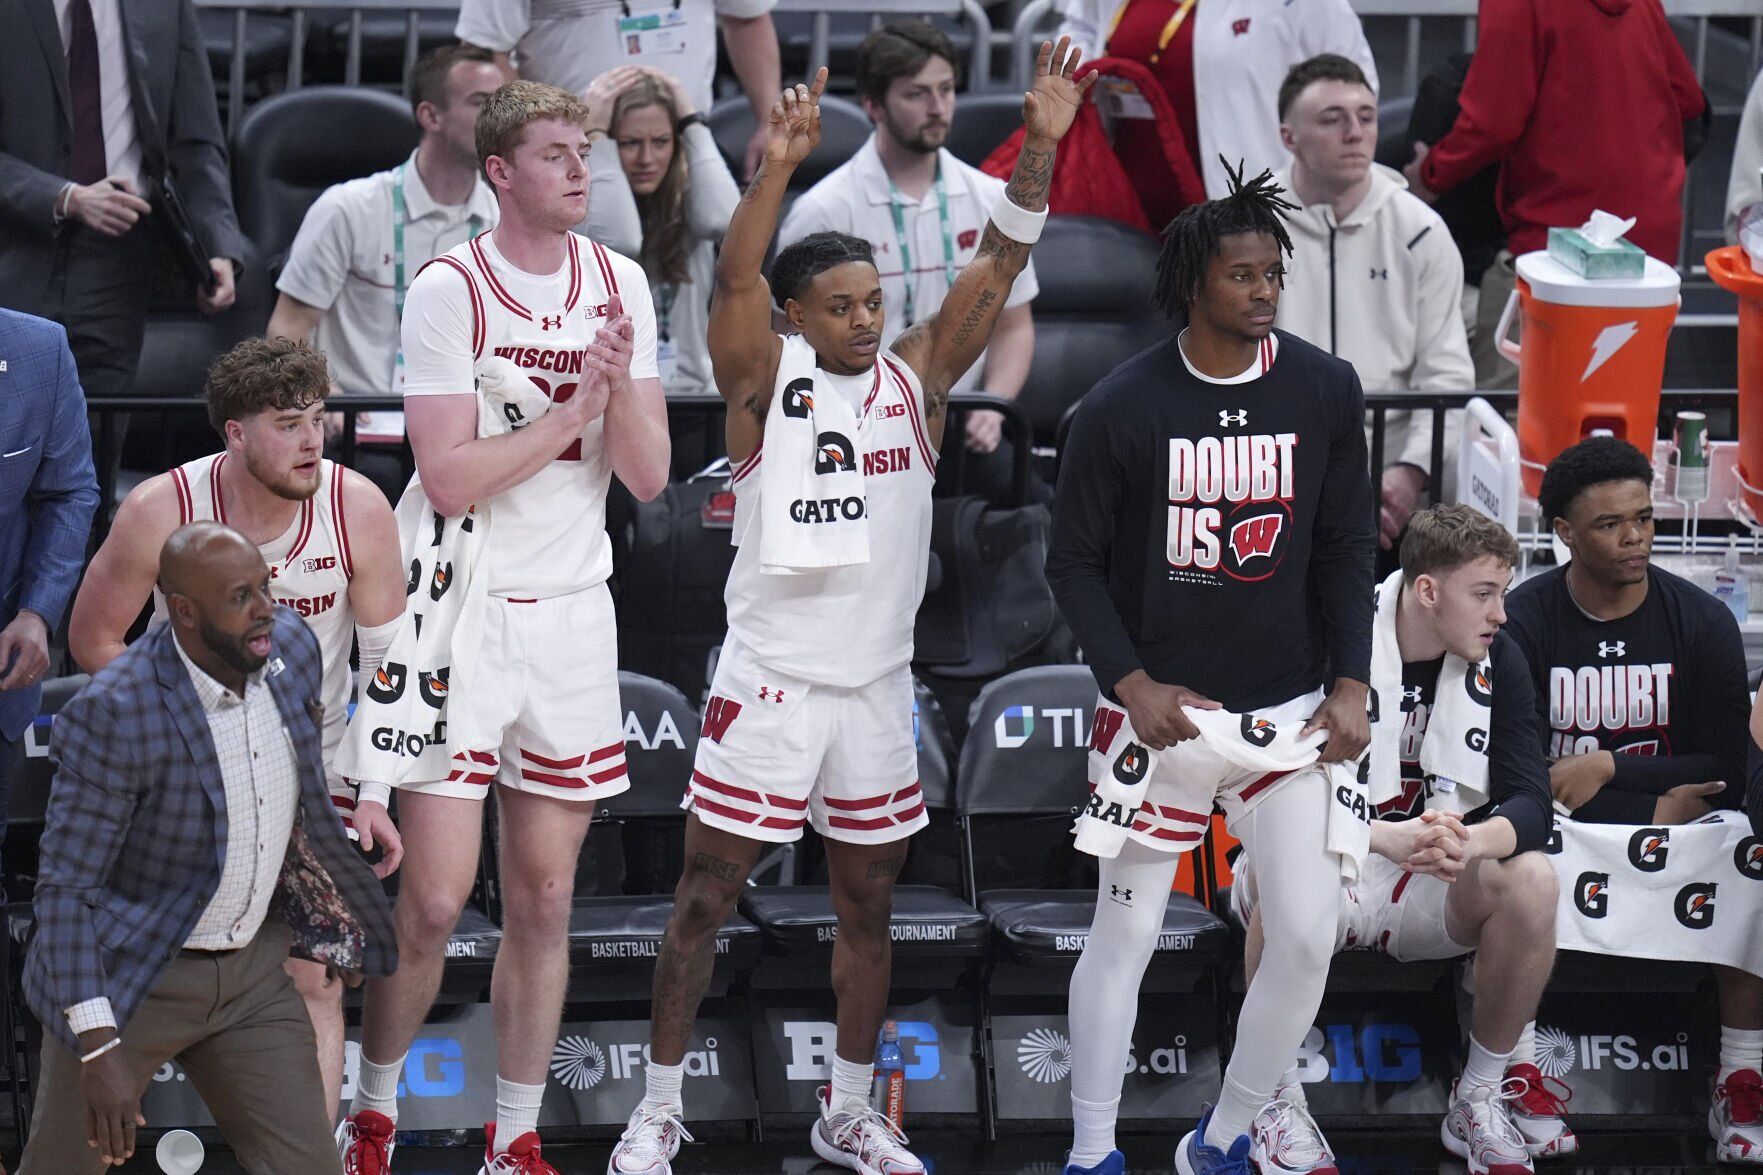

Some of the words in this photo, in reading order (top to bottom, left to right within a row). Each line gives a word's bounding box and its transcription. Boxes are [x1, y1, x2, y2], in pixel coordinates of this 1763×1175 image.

[494, 347, 588, 374] WISCON
[1168, 432, 1299, 503] DOUBT
[790, 496, 868, 523] GATO
[1166, 505, 1222, 570] US
[1549, 663, 1675, 732] DOUBT
[1042, 708, 1090, 748] TI
[591, 941, 658, 958] BASKETBALL
[1580, 1032, 1690, 1071] IFS.ai
